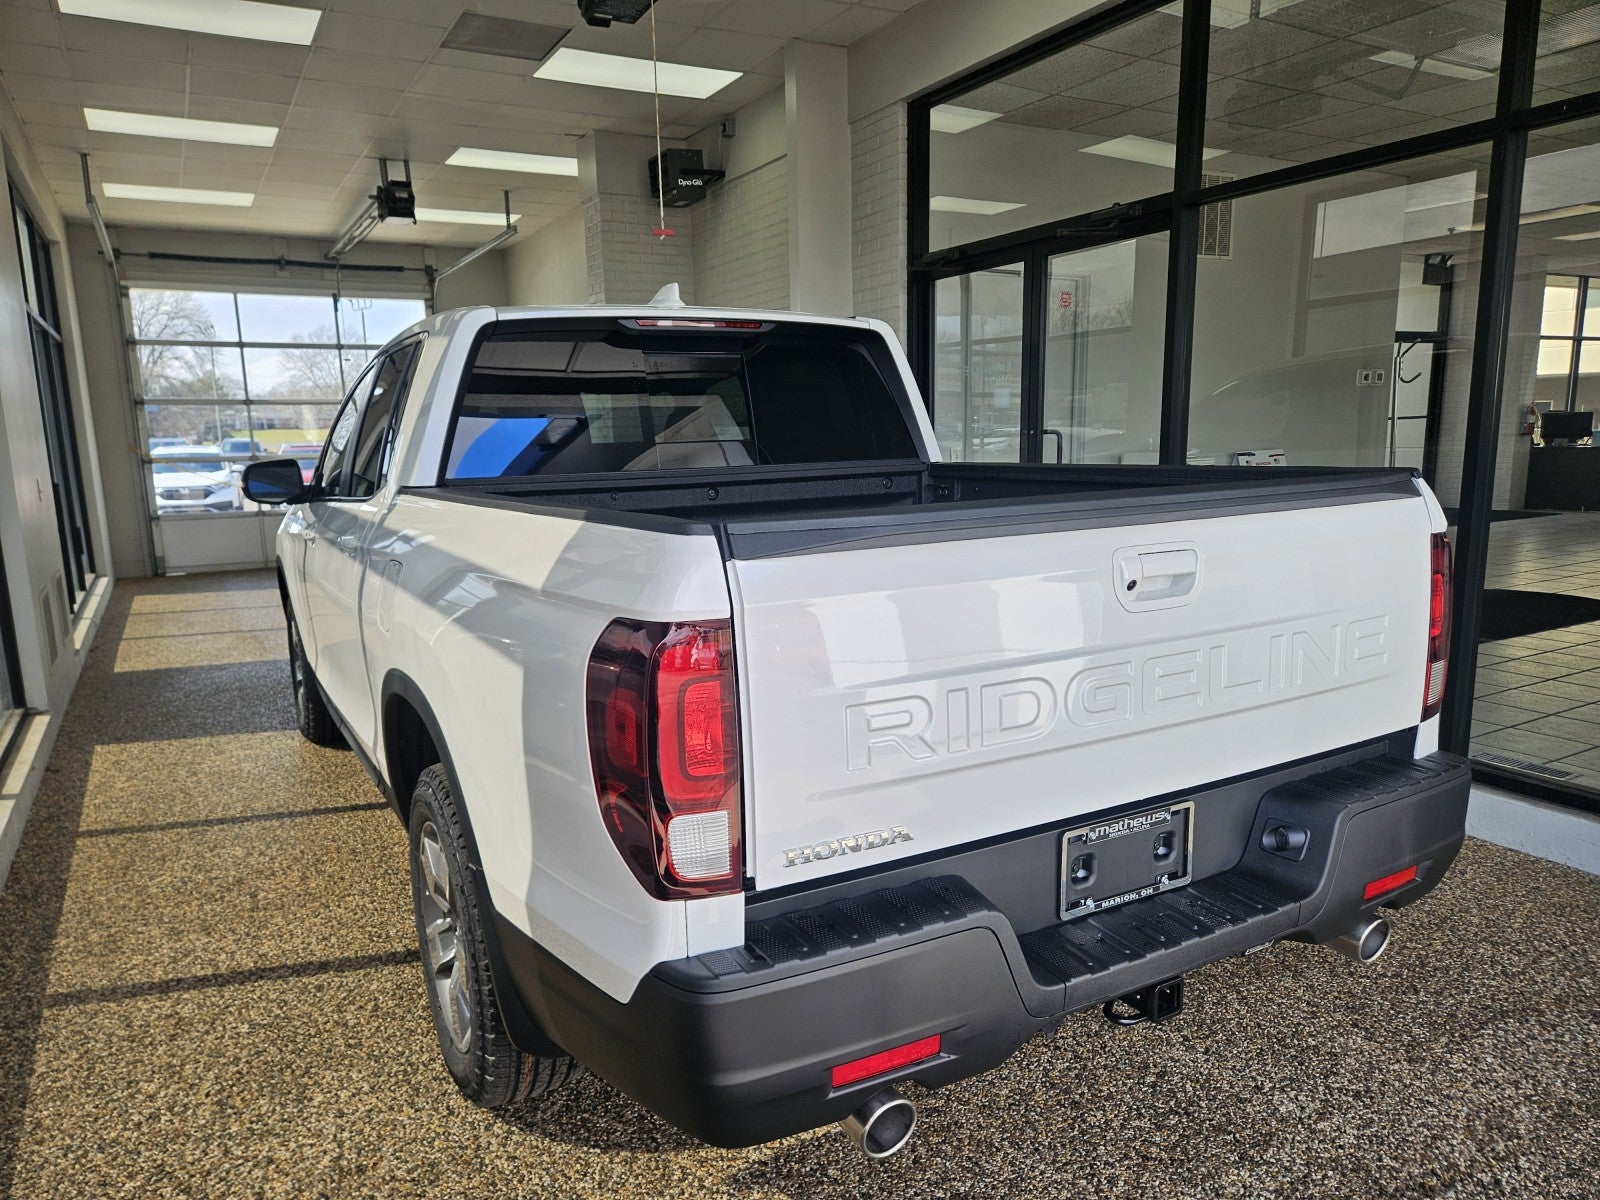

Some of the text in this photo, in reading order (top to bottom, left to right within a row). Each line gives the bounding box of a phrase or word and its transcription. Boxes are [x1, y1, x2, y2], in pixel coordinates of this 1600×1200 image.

[845, 614, 1390, 773] RIDGELINE
[783, 825, 914, 868] HONDA
[1101, 887, 1153, 908] MARION, OH
